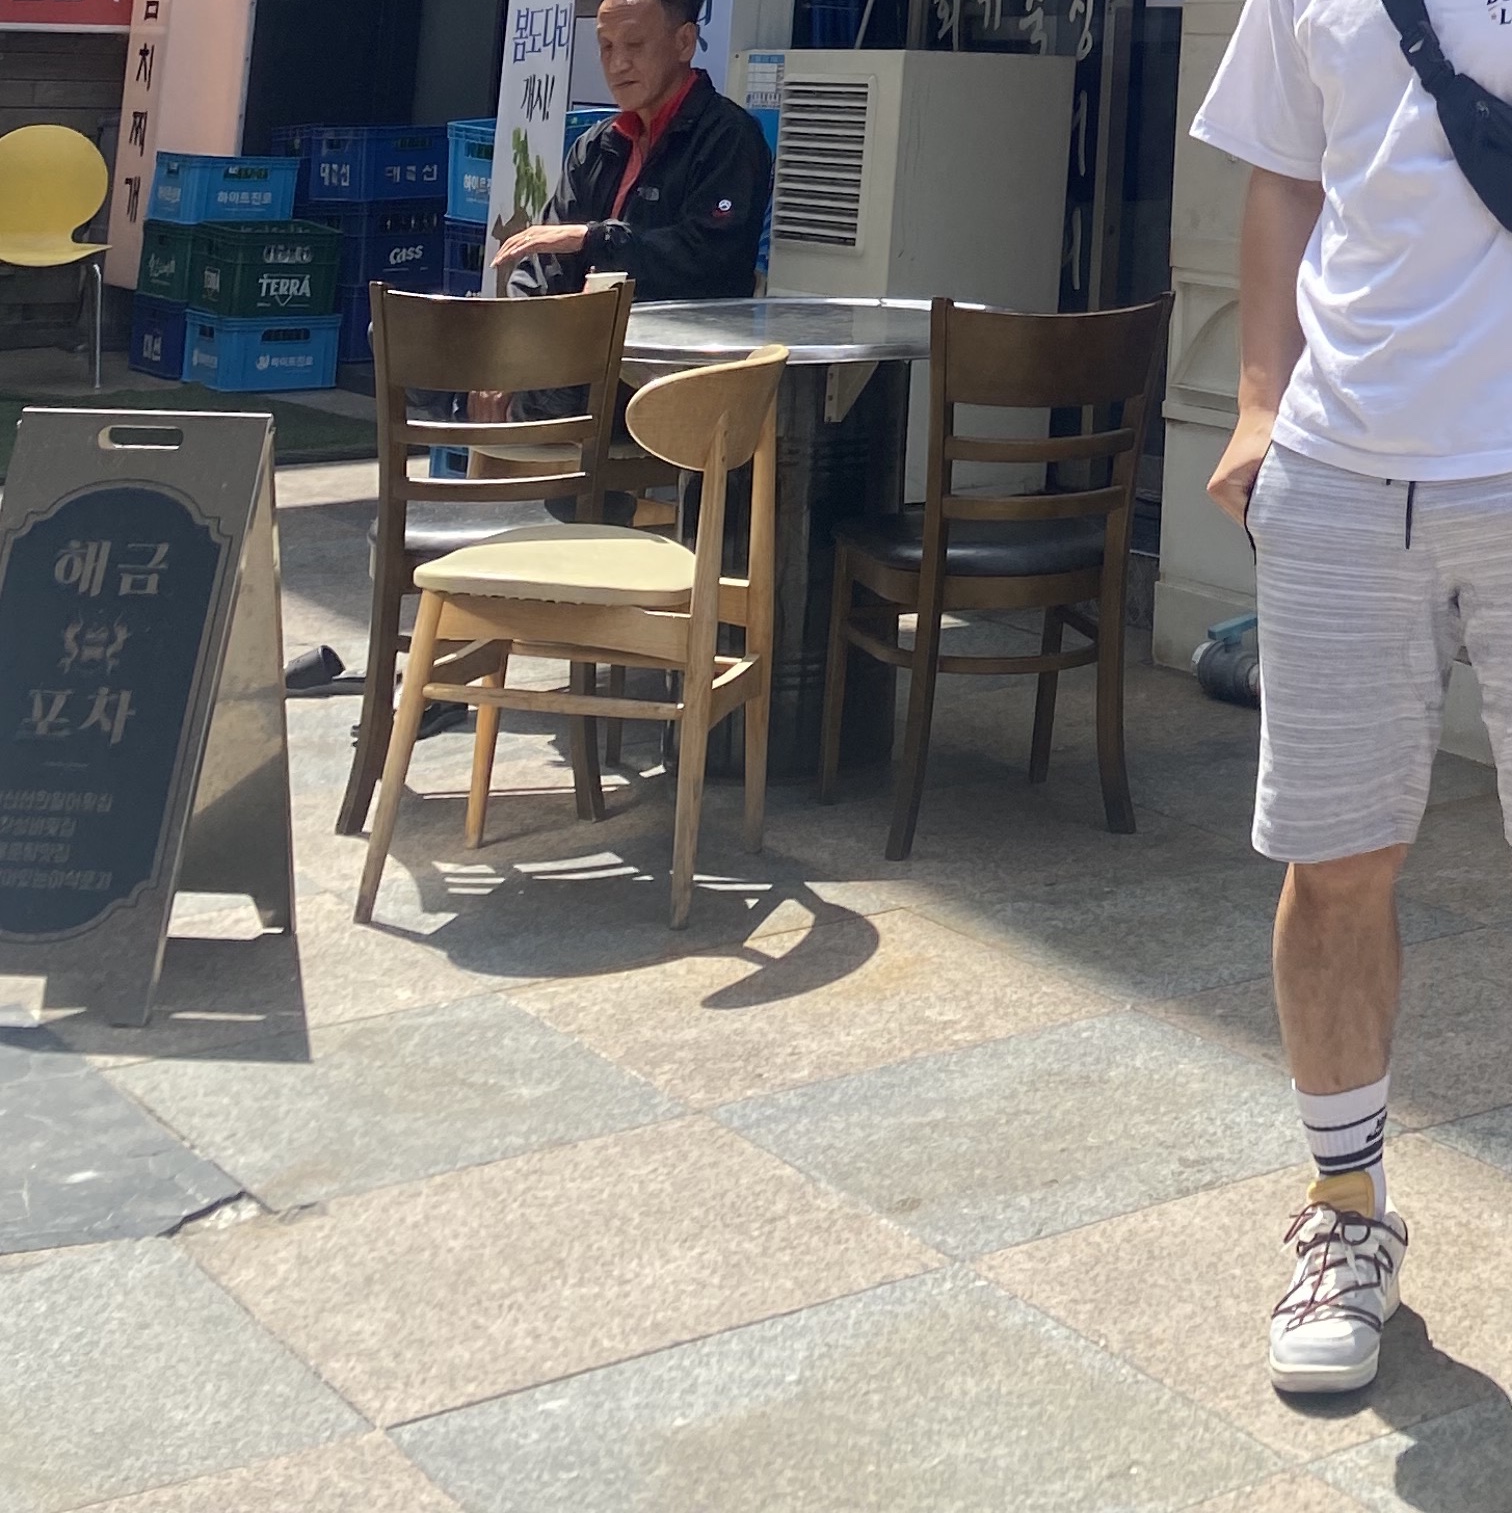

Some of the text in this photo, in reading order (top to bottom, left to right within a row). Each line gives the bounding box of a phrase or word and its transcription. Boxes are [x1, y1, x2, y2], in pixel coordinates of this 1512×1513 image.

[512, 1, 575, 64] 봄도다리
[520, 71, 557, 123] 개시!
[217, 190, 273, 206] 하이트진로
[258, 274, 312, 299] TERRA
[54, 539, 170, 598] 해금
